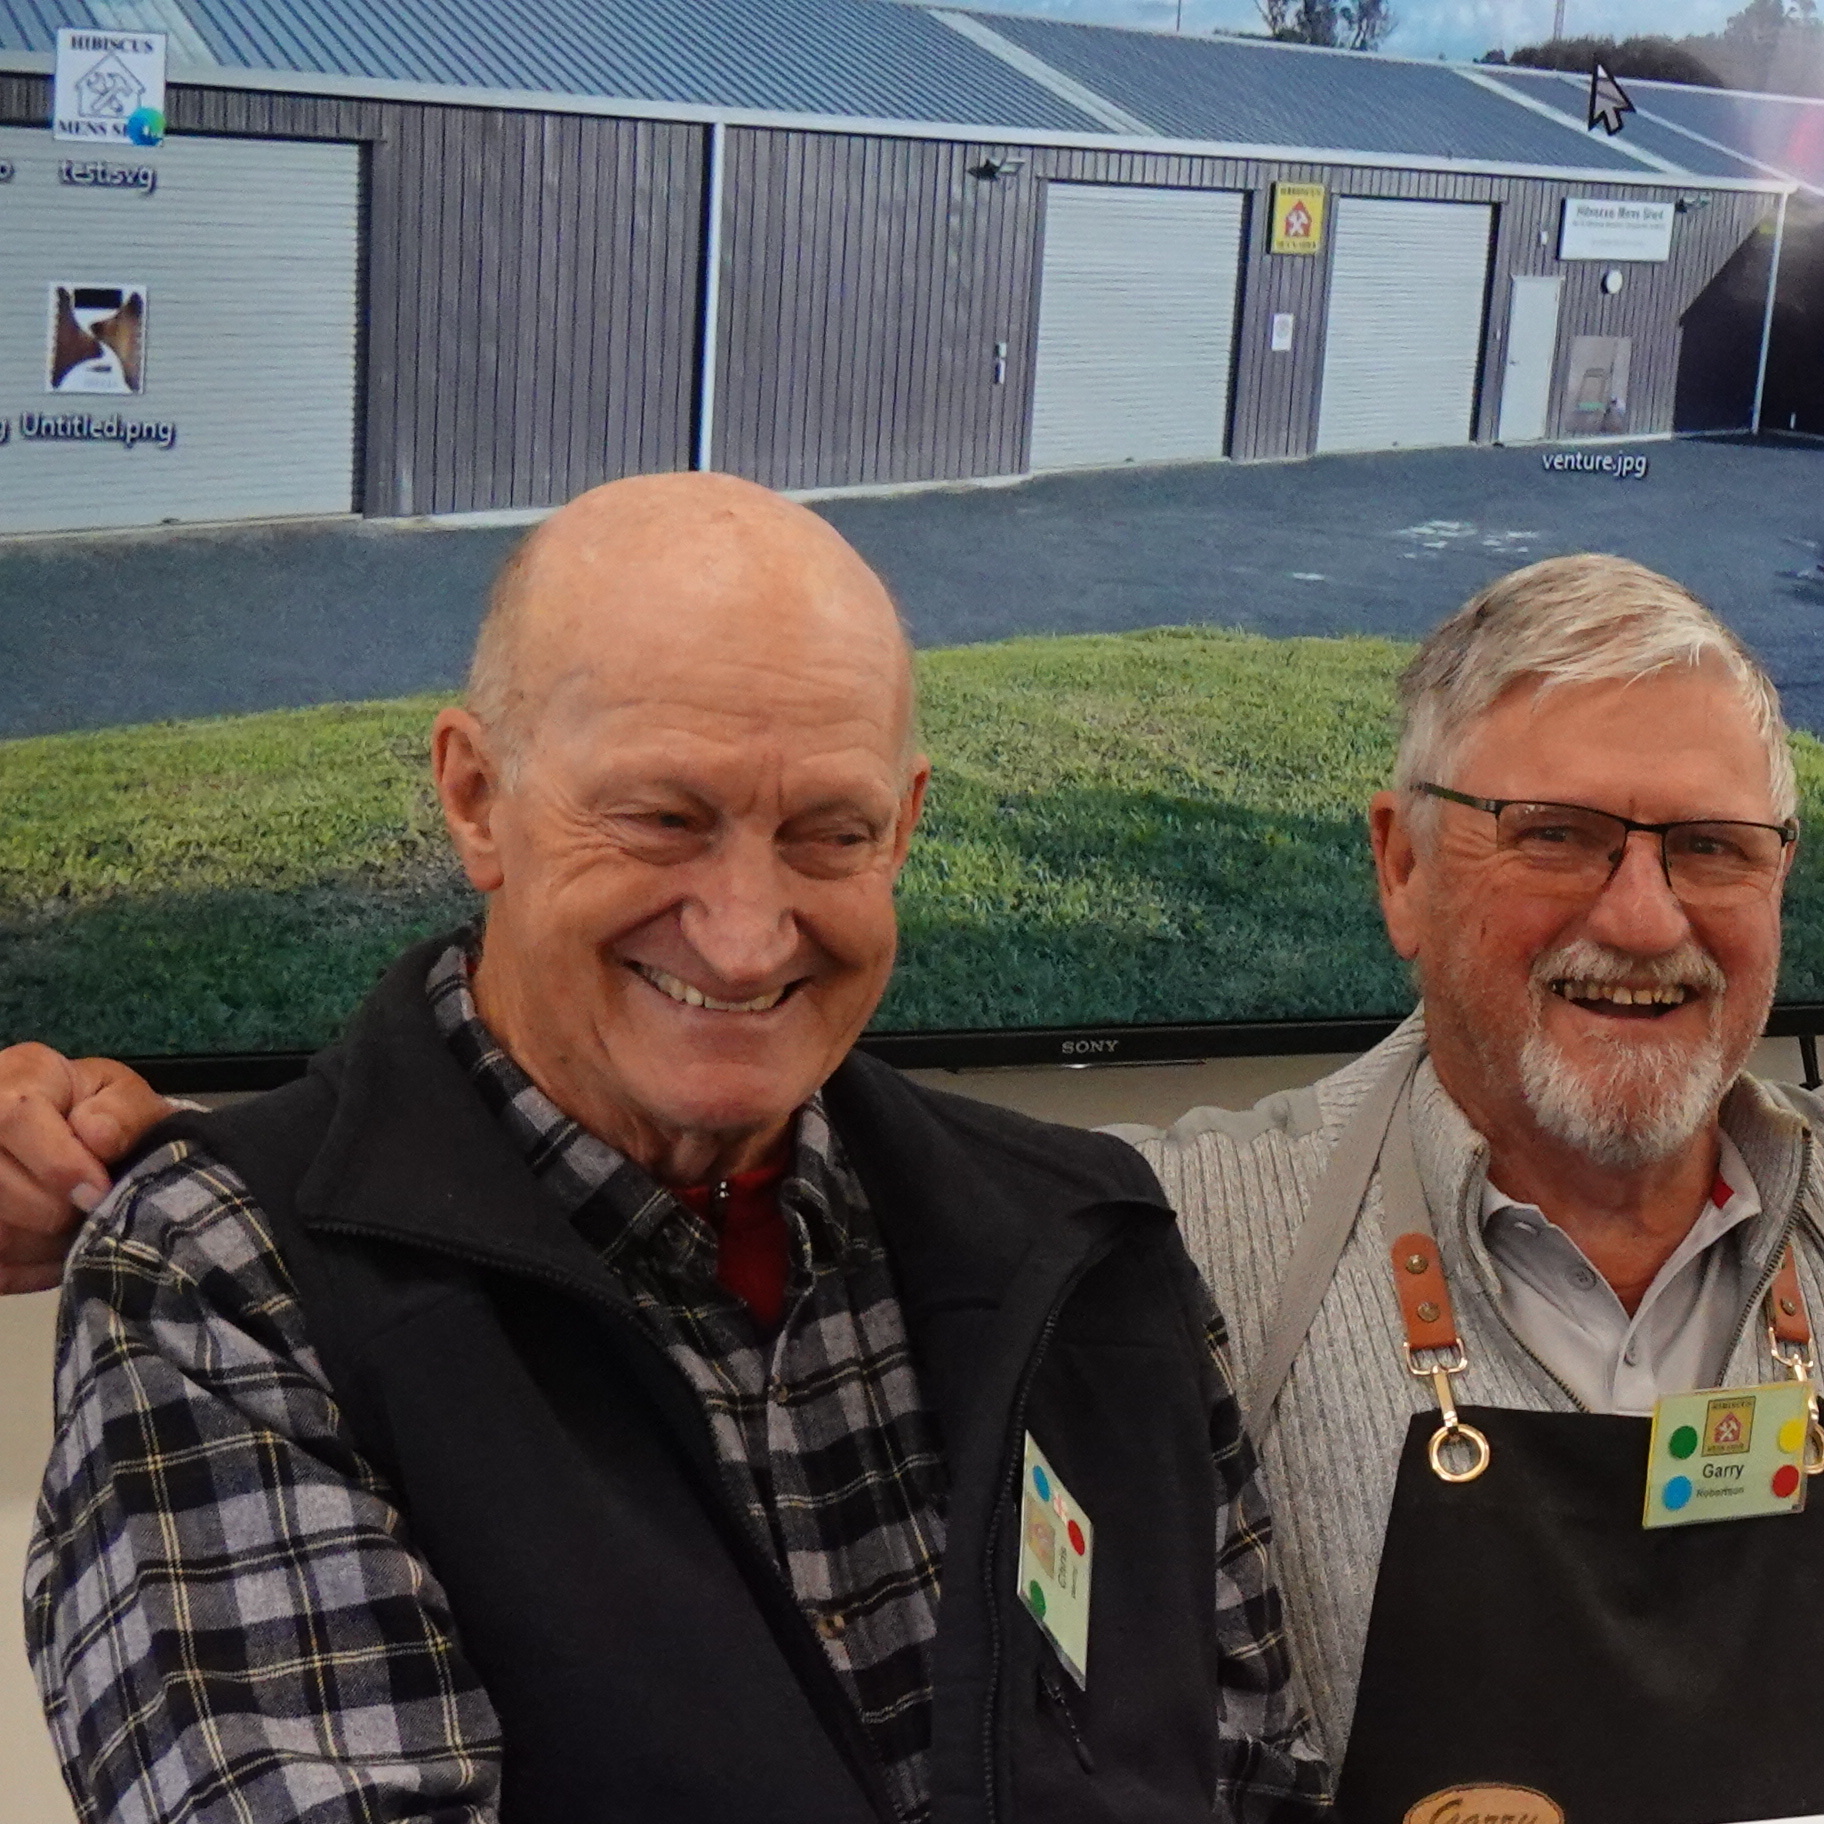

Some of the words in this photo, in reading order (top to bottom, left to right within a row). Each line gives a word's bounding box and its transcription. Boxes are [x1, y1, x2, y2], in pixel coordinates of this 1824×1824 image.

[71, 35, 154, 52] HIBISCUS
[21, 411, 174, 448] Untitled.png
[1542, 449, 1647, 478] venture.jpg
[1062, 1040, 1119, 1054] SONY
[1702, 1463, 1745, 1480] Garry
